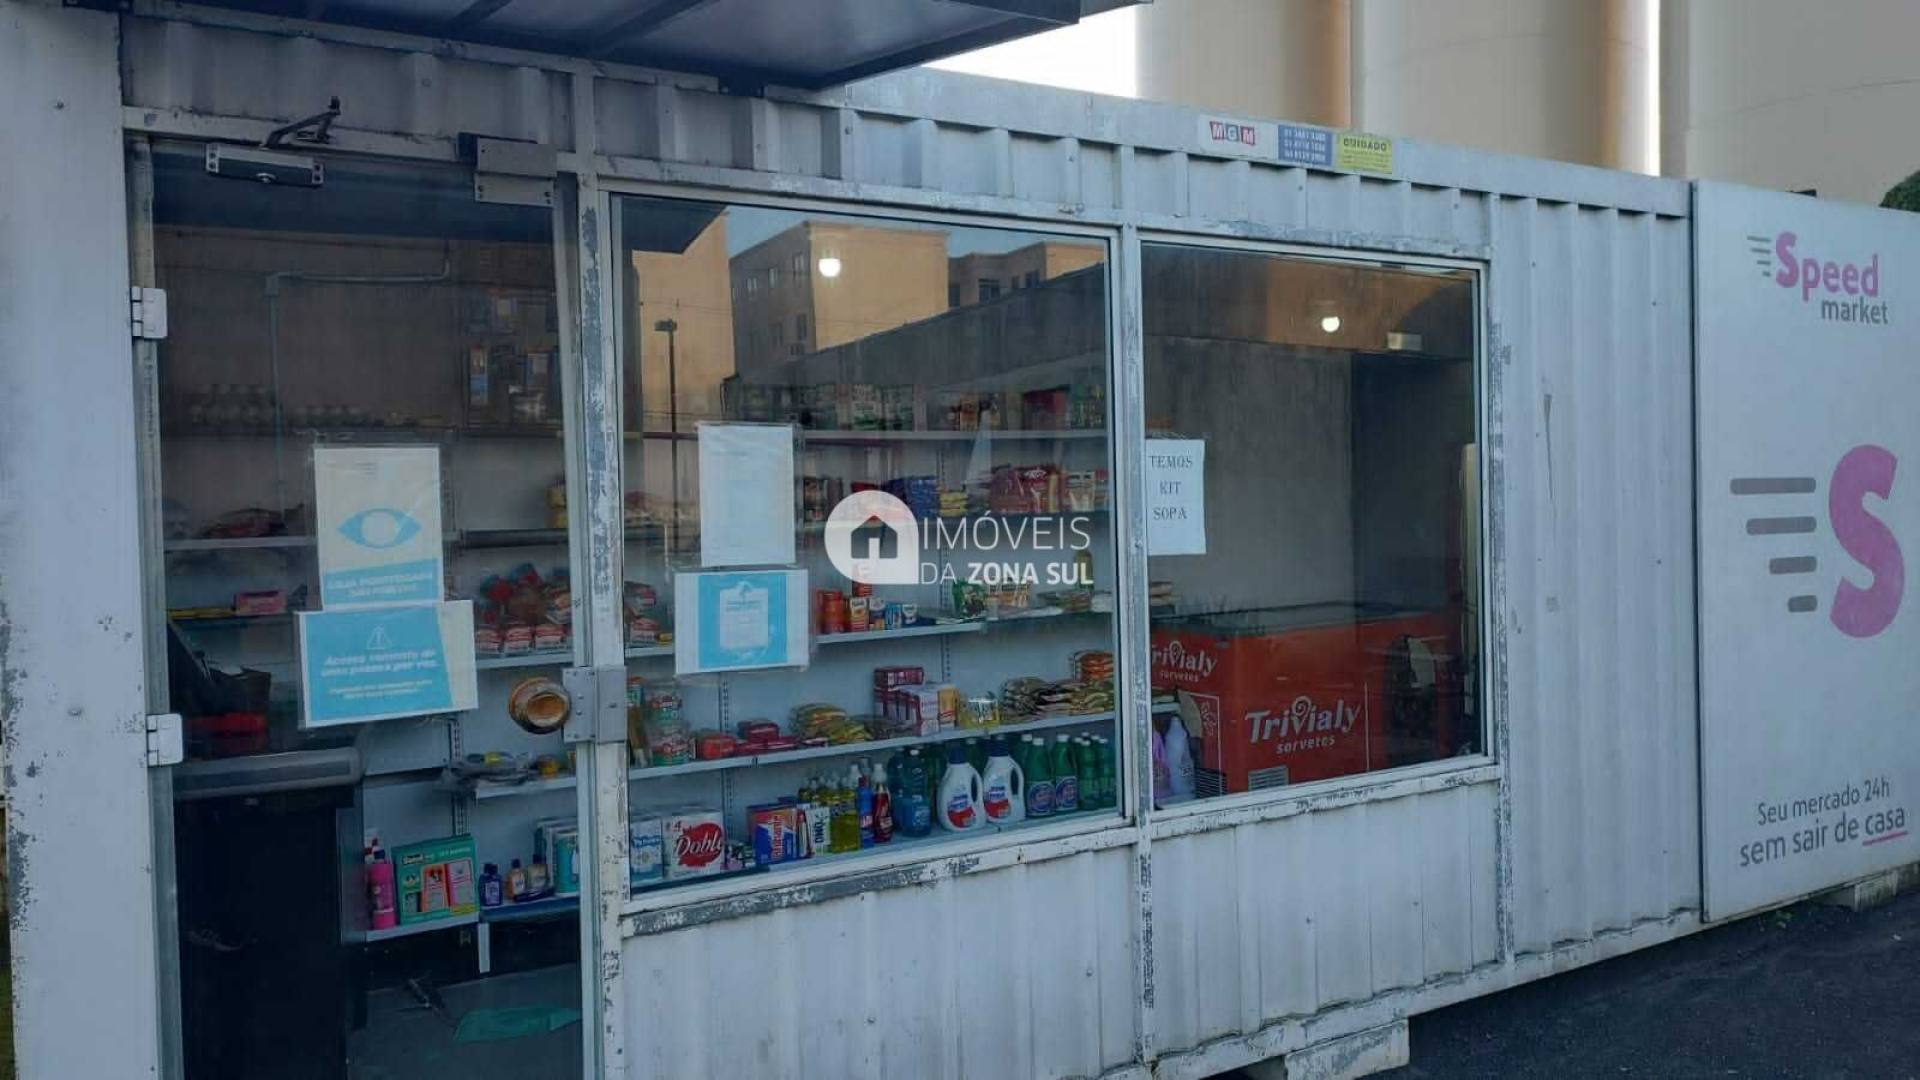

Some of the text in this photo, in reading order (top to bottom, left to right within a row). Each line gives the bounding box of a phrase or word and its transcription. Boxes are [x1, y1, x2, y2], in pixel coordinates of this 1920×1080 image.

[1210, 121, 1255, 146] MGM
[1343, 136, 1387, 151] CUIDADO
[1776, 231, 1879, 302] Speed
[1821, 296, 1889, 325] market
[1148, 455, 1193, 469] TEMOS
[1159, 480, 1181, 494] KIT
[1153, 507, 1187, 520] SOPA
[1828, 444, 1905, 638] S
[1151, 640, 1217, 677] rivialy
[1160, 670, 1199, 682] sorvetes
[1277, 734, 1336, 755] sorvetes
[1758, 776, 1890, 826] Seu mercado 24h
[1740, 807, 1905, 867] sem sair de casa
